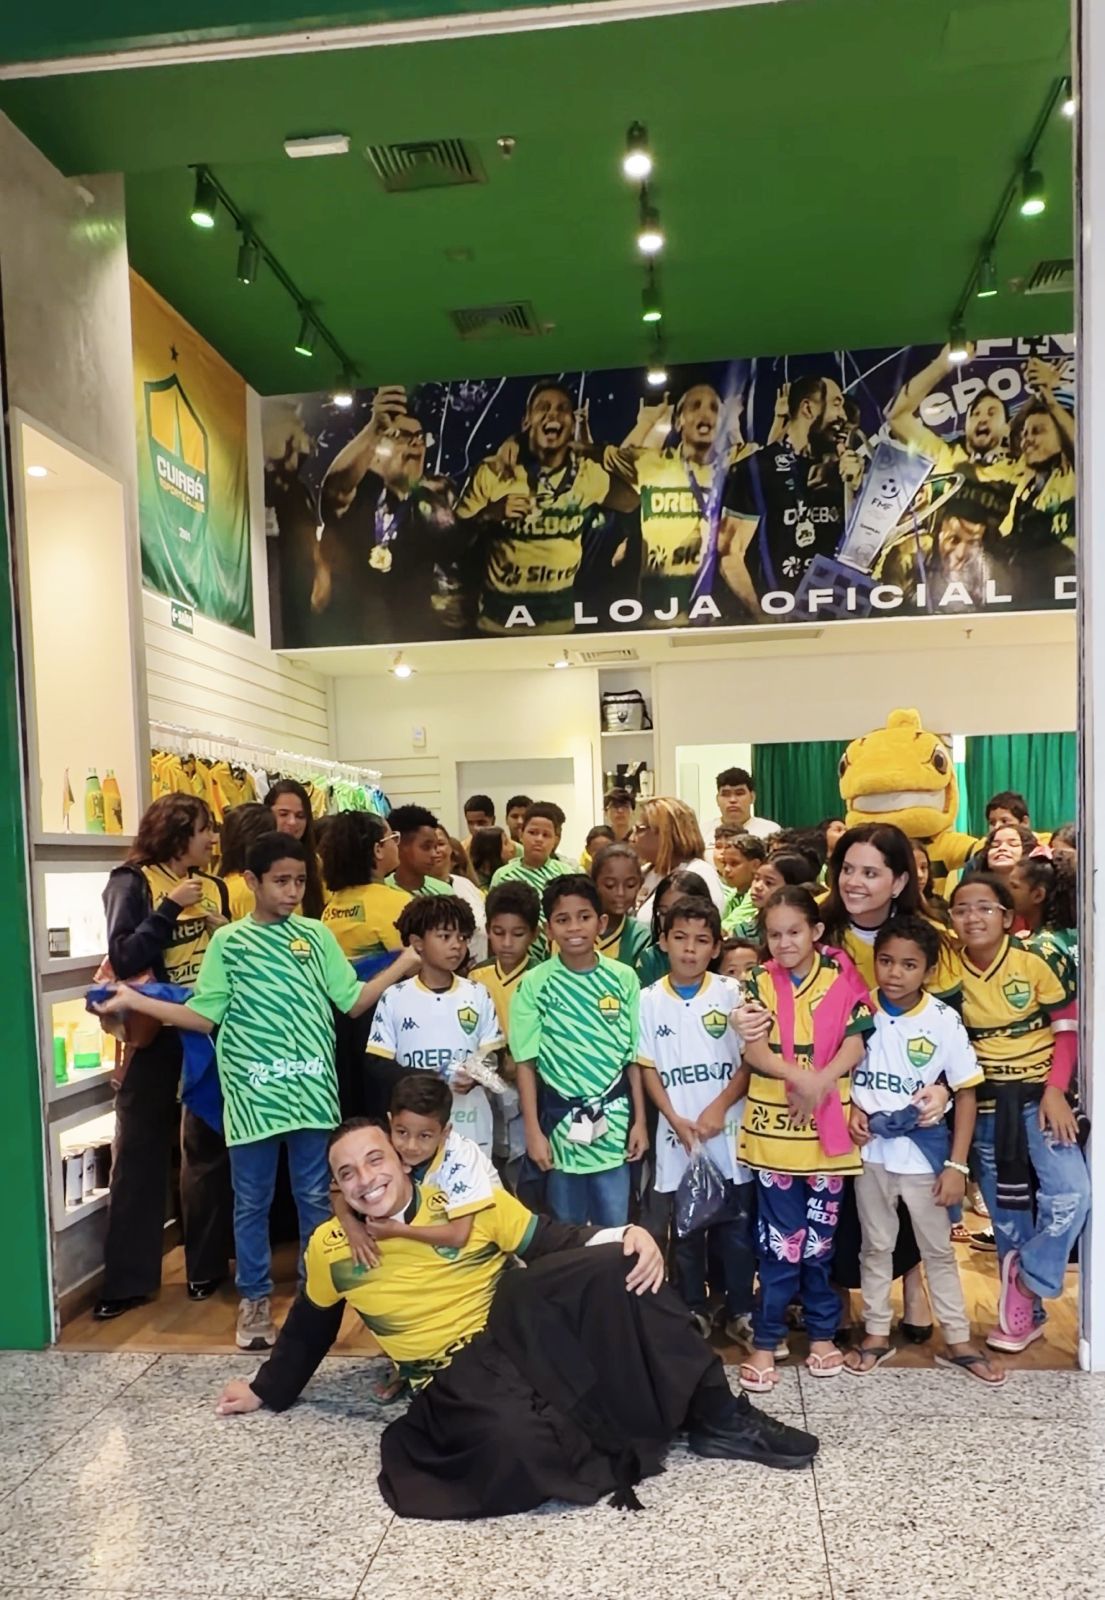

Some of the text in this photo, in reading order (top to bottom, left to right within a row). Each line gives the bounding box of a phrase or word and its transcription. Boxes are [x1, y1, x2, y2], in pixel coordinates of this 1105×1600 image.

[504, 605, 536, 628] A
[574, 595, 722, 625] LOJA
[761, 574, 1012, 615] OFICIAL
